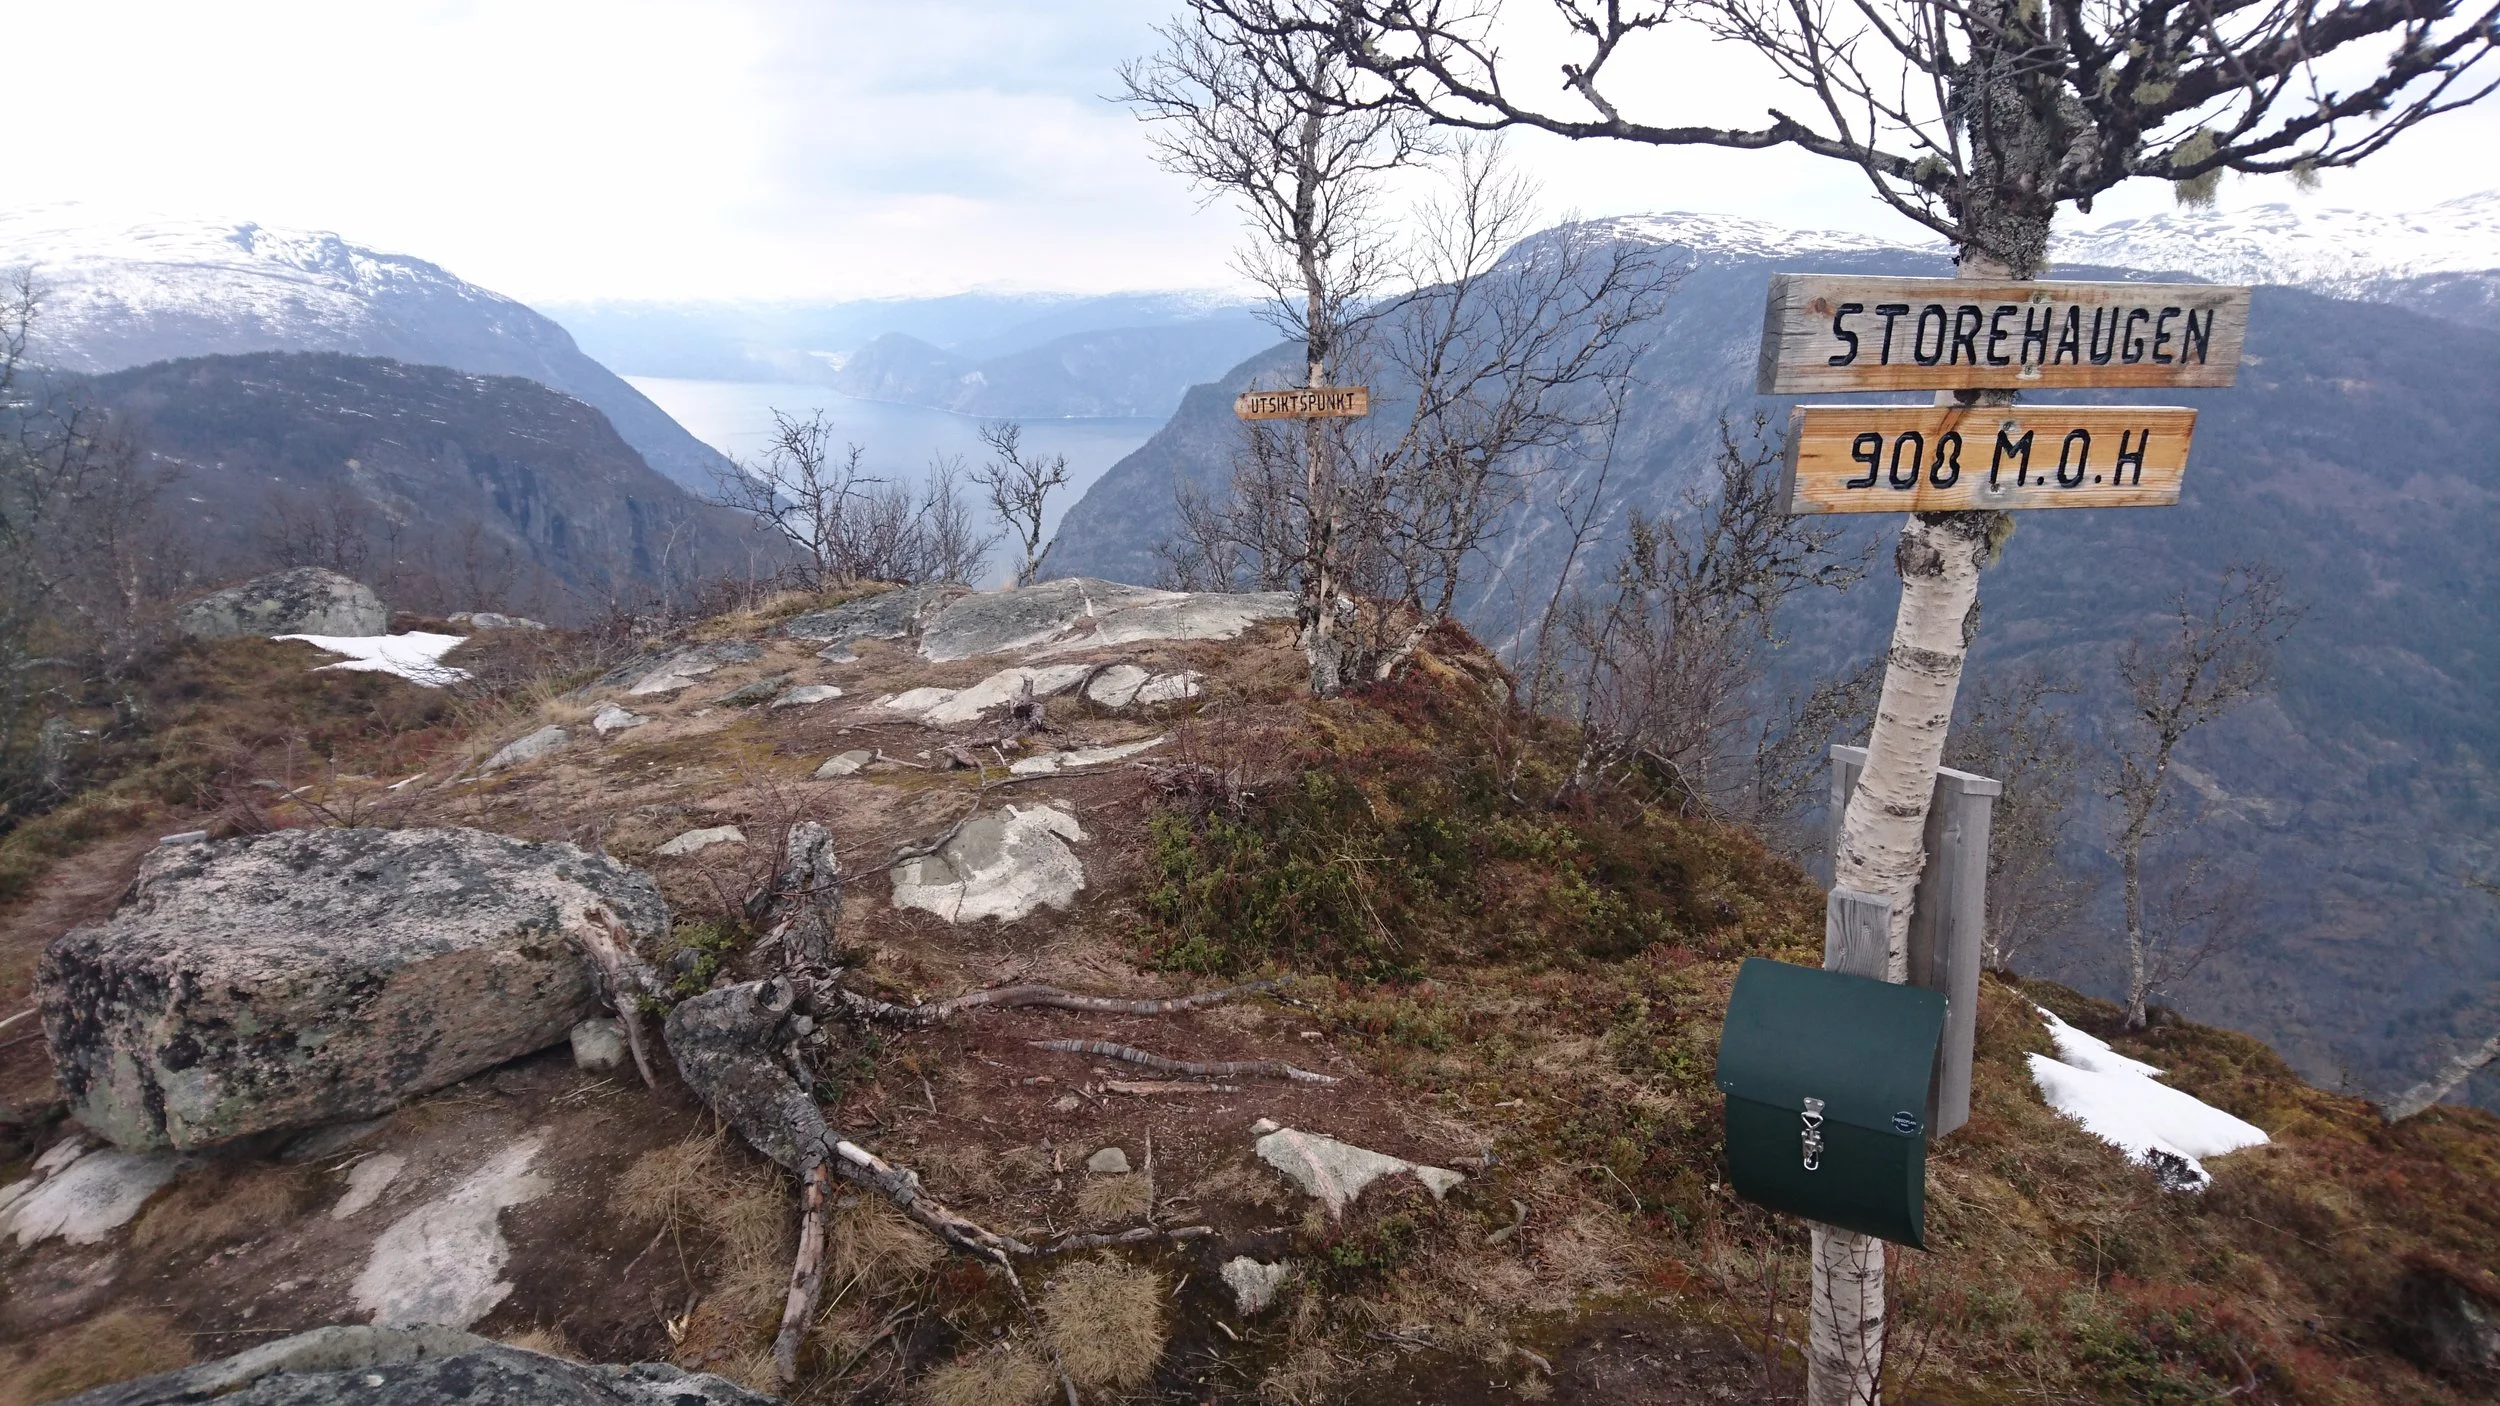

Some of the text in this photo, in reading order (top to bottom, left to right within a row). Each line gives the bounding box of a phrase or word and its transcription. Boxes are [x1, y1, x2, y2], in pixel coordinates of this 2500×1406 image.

[1828, 302, 2214, 367] STOREHAUGEN
[1251, 392, 1355, 414] UTSIKTSPUNKT
[1846, 428, 2150, 490] 908 M.O.H
